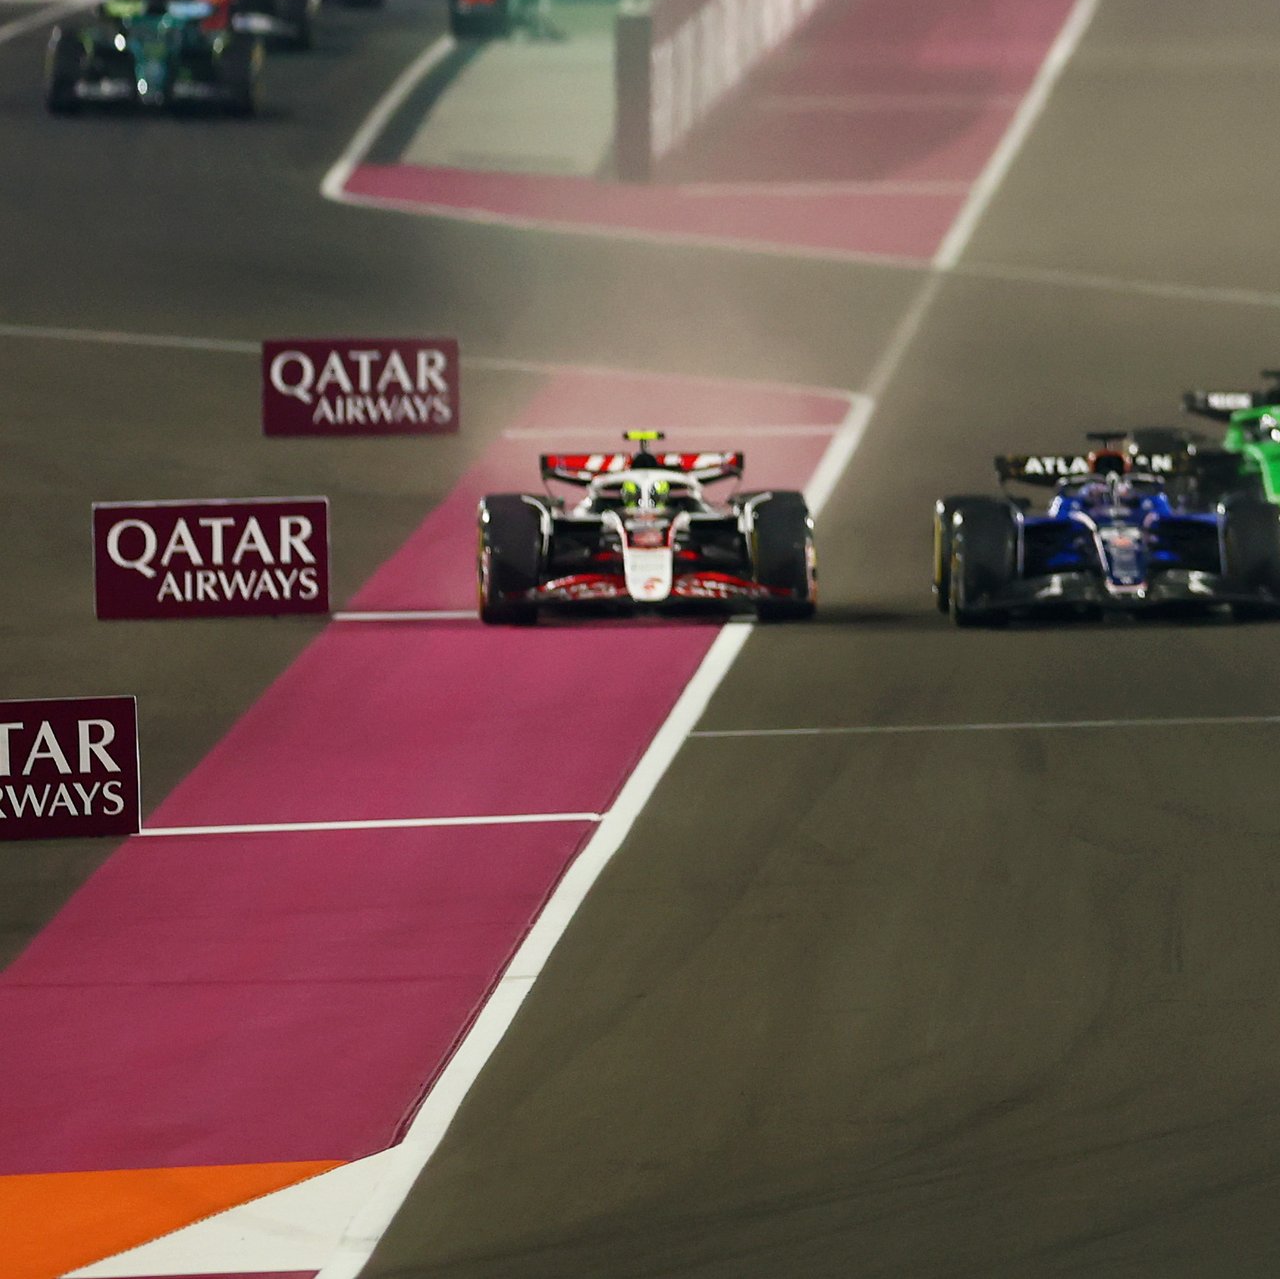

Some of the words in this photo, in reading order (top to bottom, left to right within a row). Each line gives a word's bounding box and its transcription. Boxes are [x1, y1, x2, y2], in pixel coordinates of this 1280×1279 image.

[270, 349, 450, 403] QATAR
[312, 394, 453, 424] AIRWAYS
[106, 515, 317, 577] QATAR
[156, 567, 320, 603] AIRWAYS
